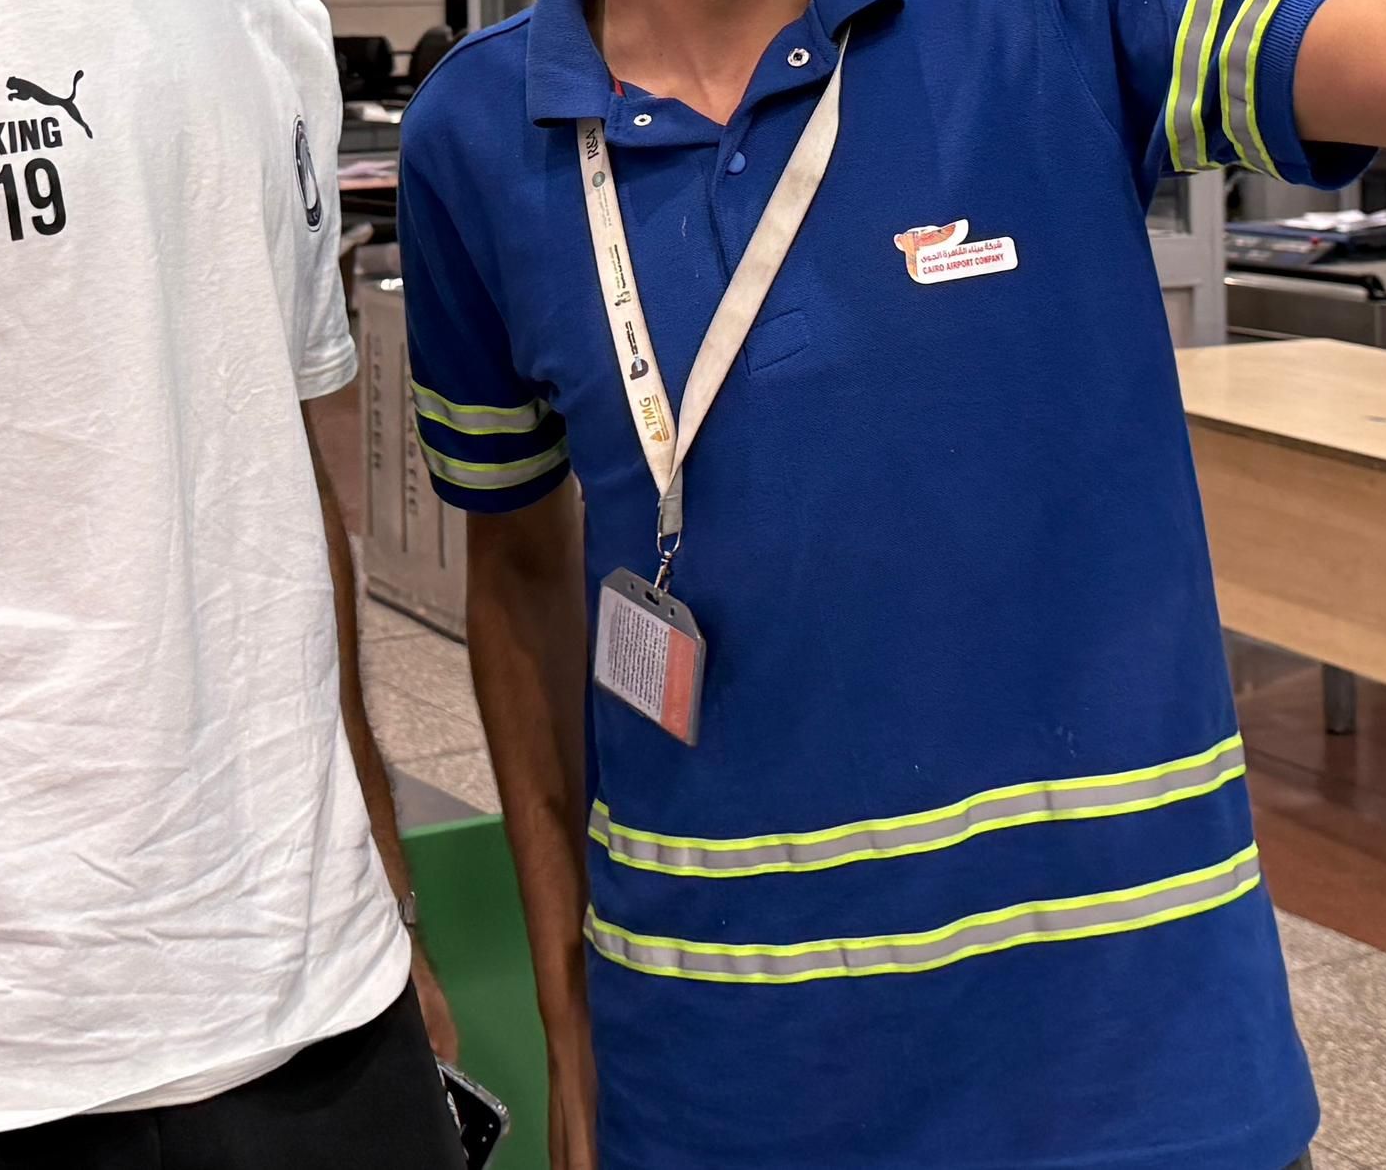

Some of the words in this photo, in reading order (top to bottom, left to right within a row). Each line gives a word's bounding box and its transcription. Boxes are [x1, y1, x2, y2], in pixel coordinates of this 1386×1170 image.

[922, 264, 945, 274] CAIRO
[946, 258, 974, 271] AIRPORT
[974, 253, 1005, 266] COMPANY
[639, 396, 658, 430] TMG
